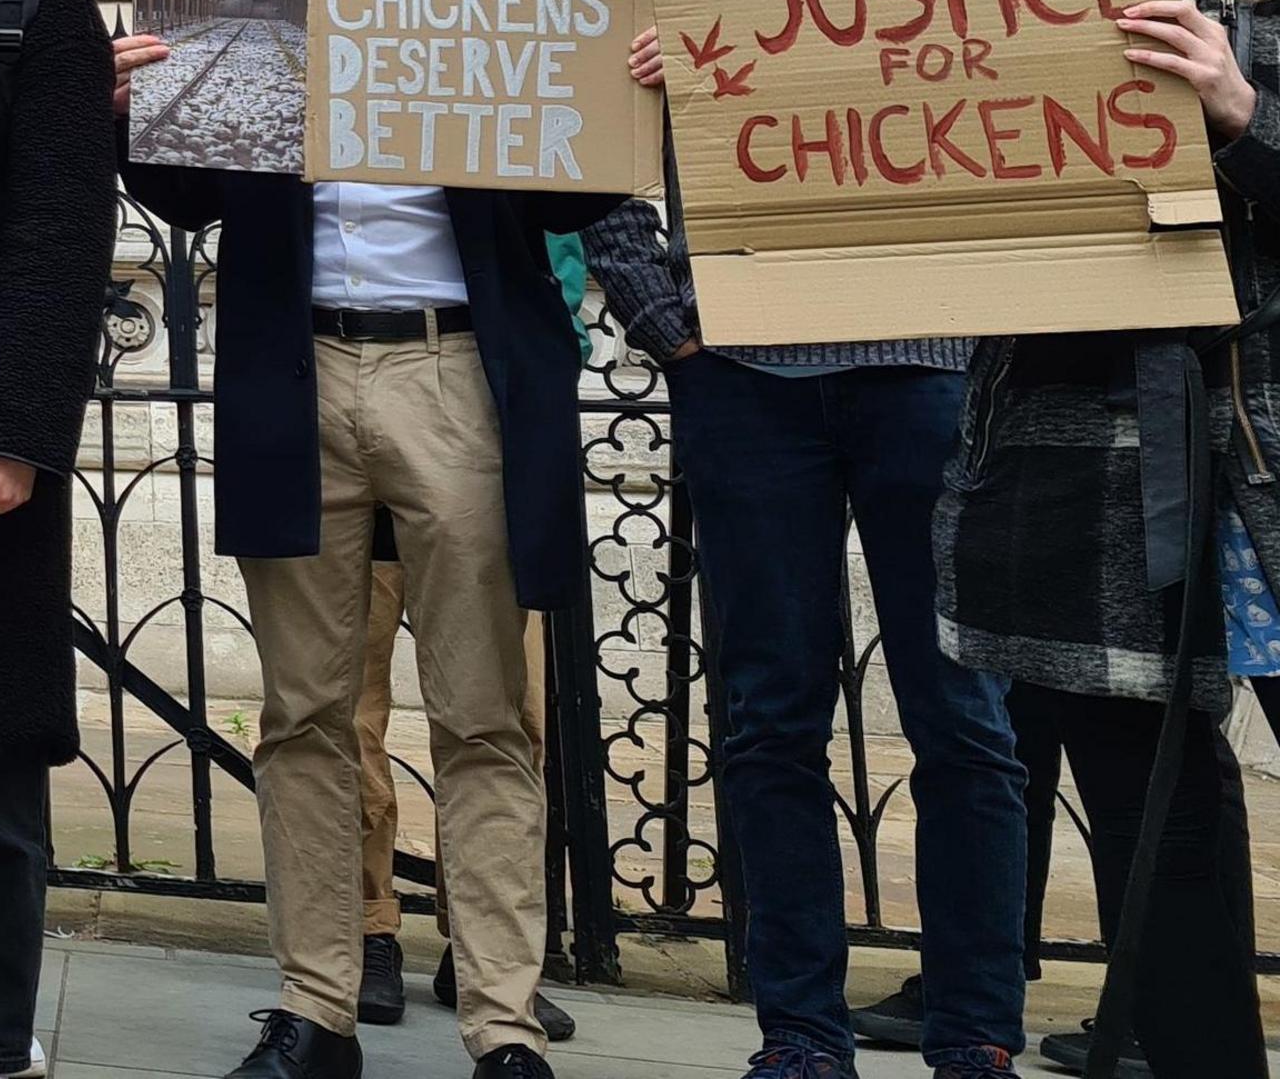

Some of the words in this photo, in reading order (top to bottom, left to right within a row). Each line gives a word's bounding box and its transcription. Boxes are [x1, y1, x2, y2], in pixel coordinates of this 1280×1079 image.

[328, 34, 577, 98] DESERVE
[879, 38, 999, 86] FOR
[329, 98, 583, 181] BETTER
[737, 79, 1177, 187] CHICKENS
